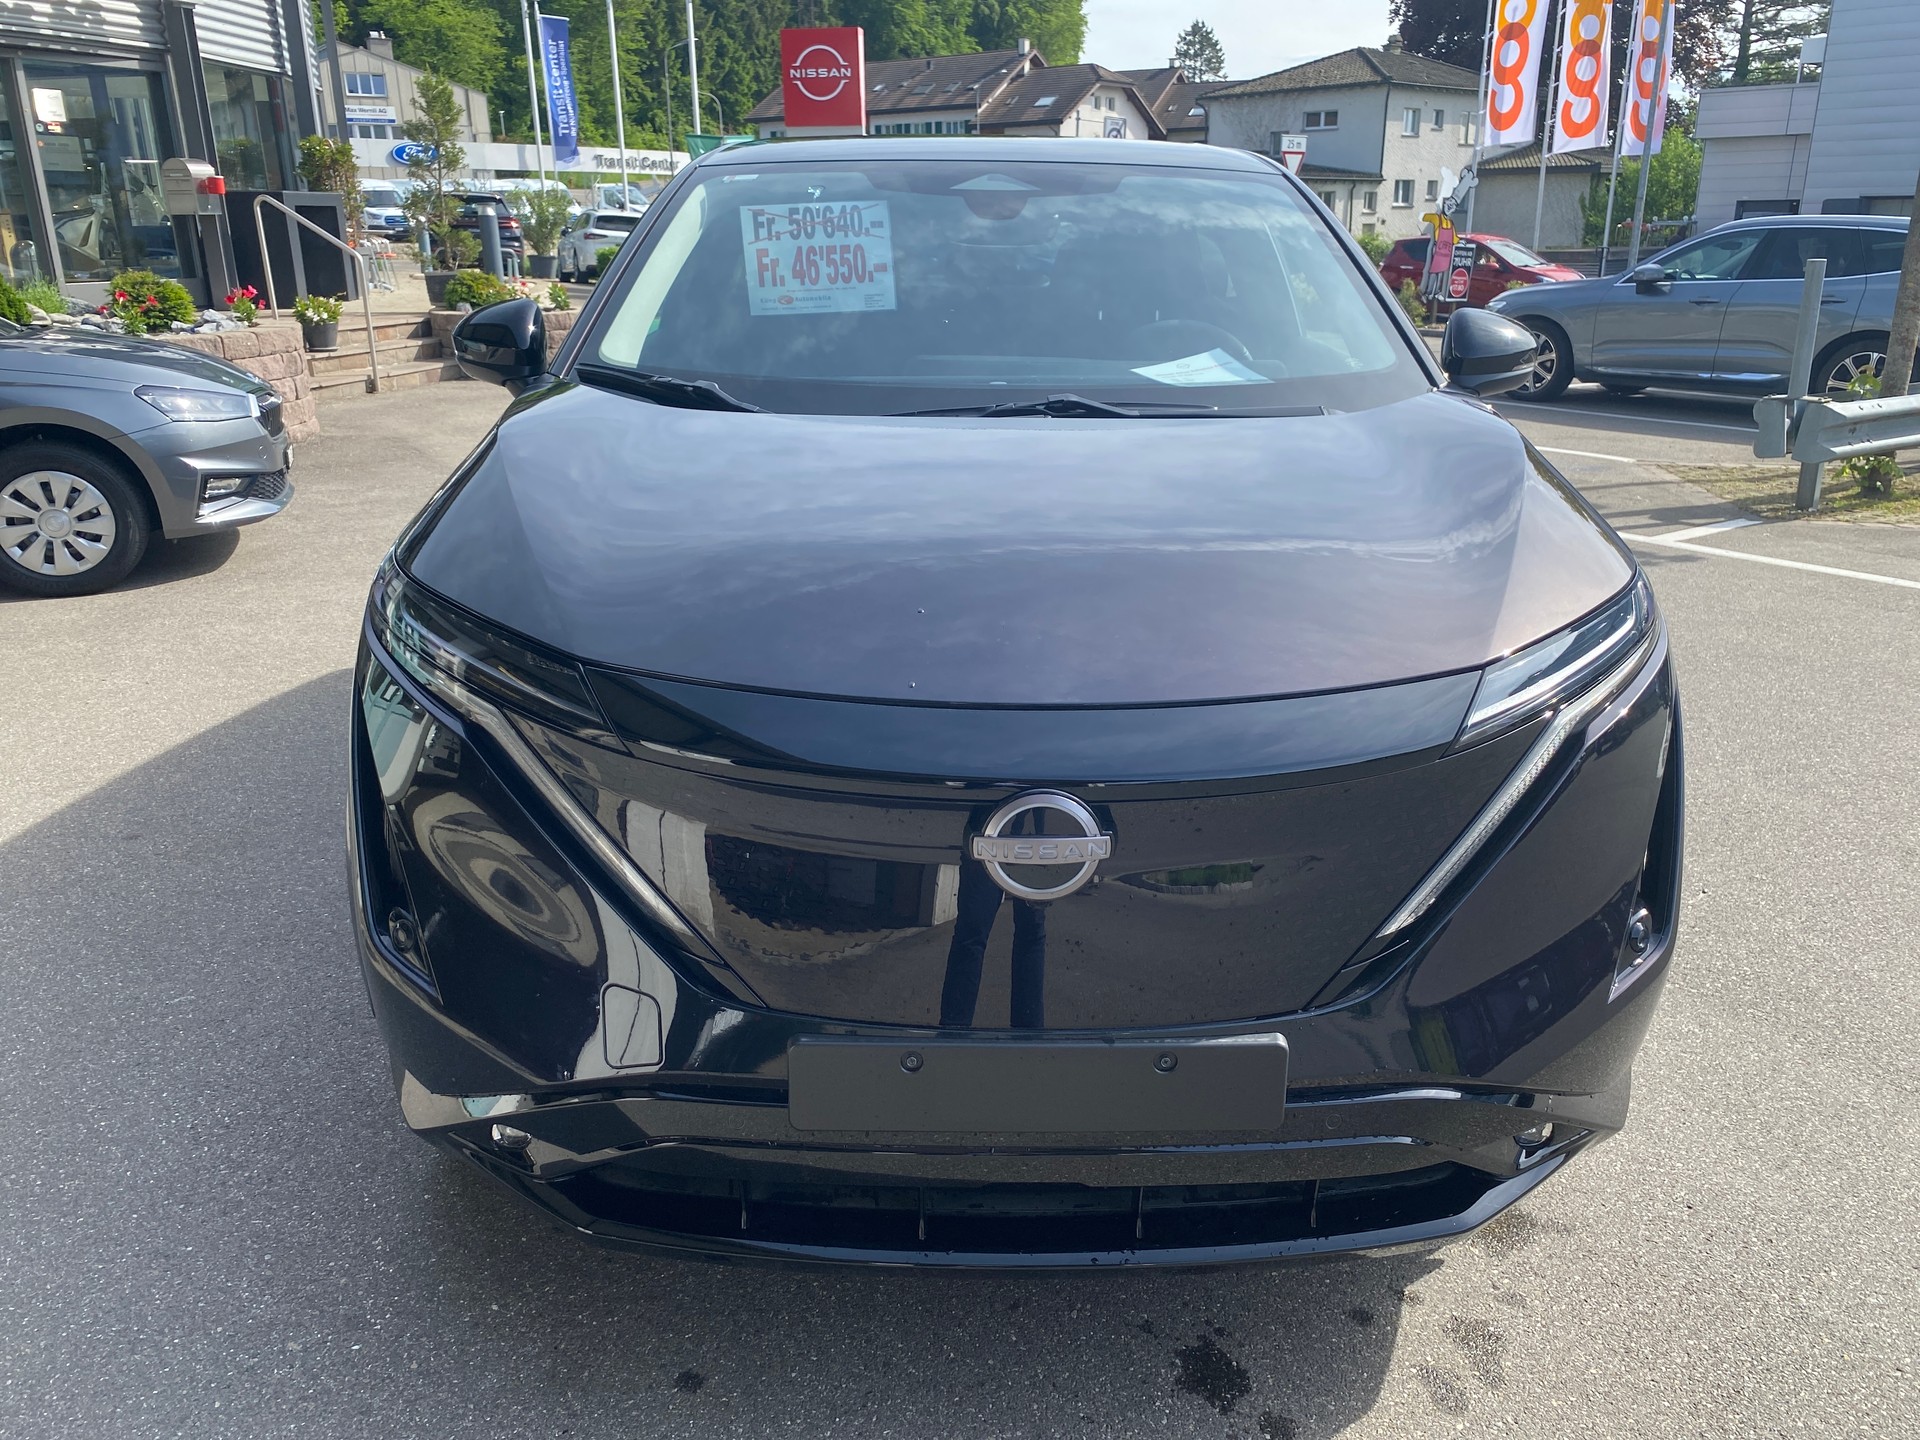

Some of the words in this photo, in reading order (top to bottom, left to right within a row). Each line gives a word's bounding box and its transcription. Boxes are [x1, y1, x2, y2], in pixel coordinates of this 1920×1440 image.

[548, 39, 561, 86] Center
[789, 68, 852, 78] NISSAN
[552, 89, 570, 137] Transit
[1287, 139, 1295, 149] 25
[593, 154, 639, 169] Transit
[641, 157, 680, 171] Center
[752, 208, 781, 241] Fr.
[756, 248, 785, 288] Fr.
[792, 243, 887, 286] 46'550.-
[977, 842, 1107, 859] NISSAN
